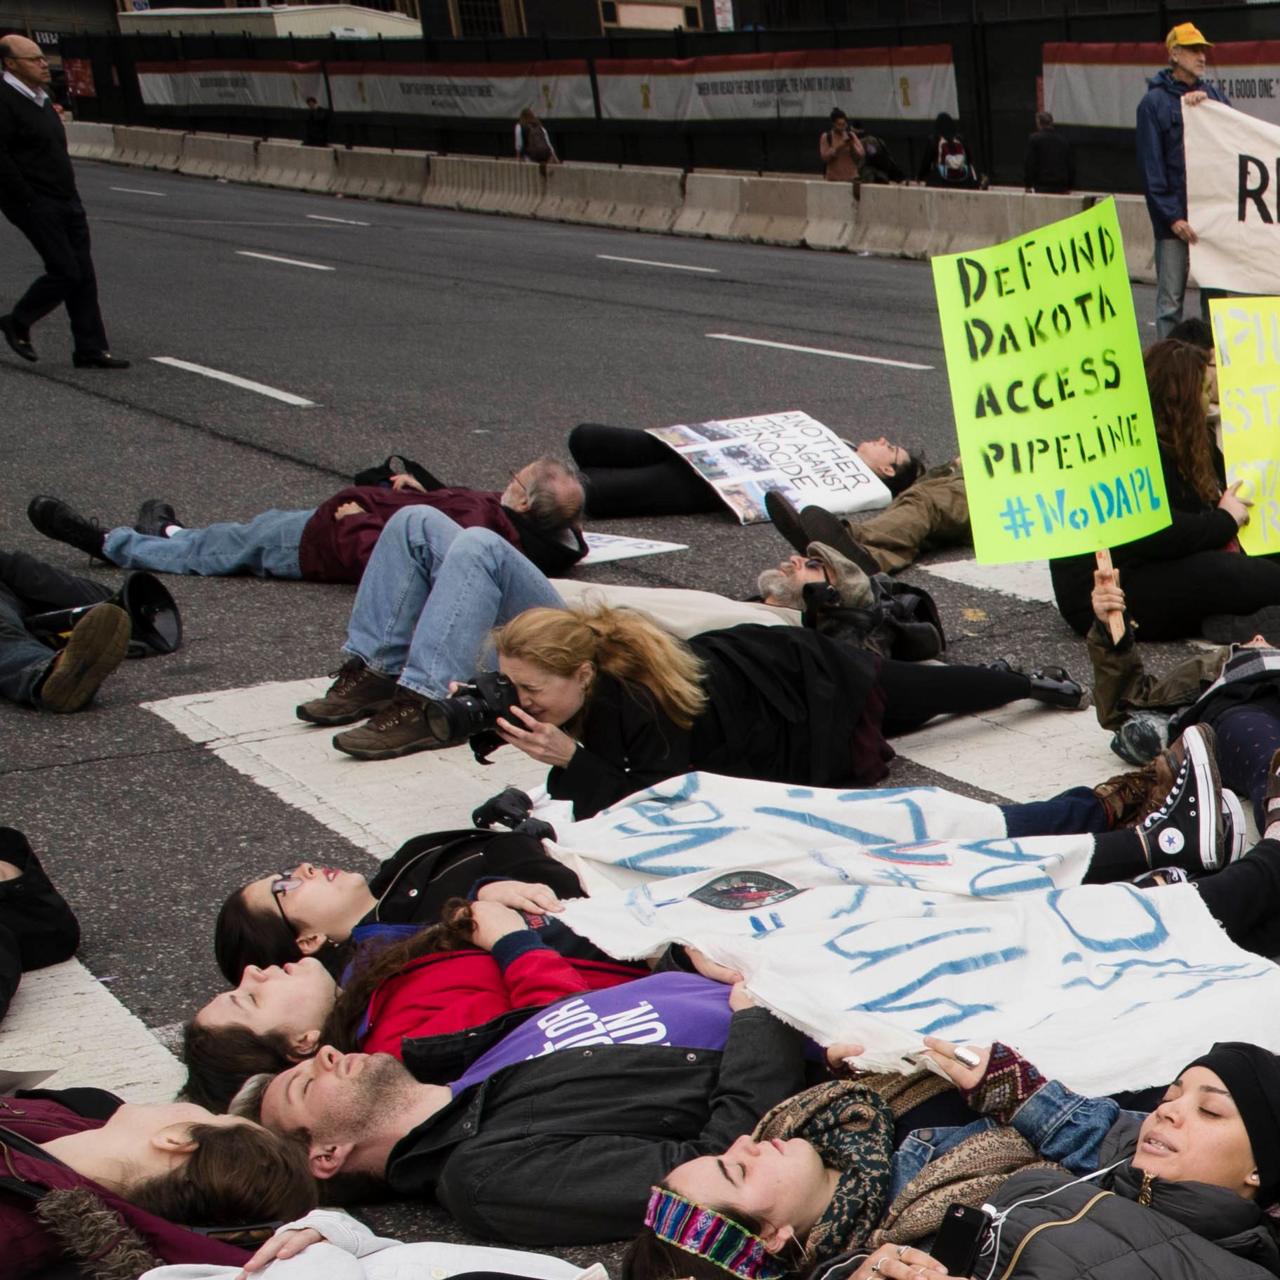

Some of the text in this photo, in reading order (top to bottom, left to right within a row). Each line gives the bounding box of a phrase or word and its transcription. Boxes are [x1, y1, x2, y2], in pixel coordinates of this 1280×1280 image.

[1235, 79, 1257, 98] GOOD
[964, 284, 1117, 361] DAKOTA
[974, 348, 1122, 418] ACCESS
[725, 420, 819, 490] GENOCIDE
[749, 417, 851, 493] JEW AGAINST
[783, 413, 871, 489] ANOTHER
